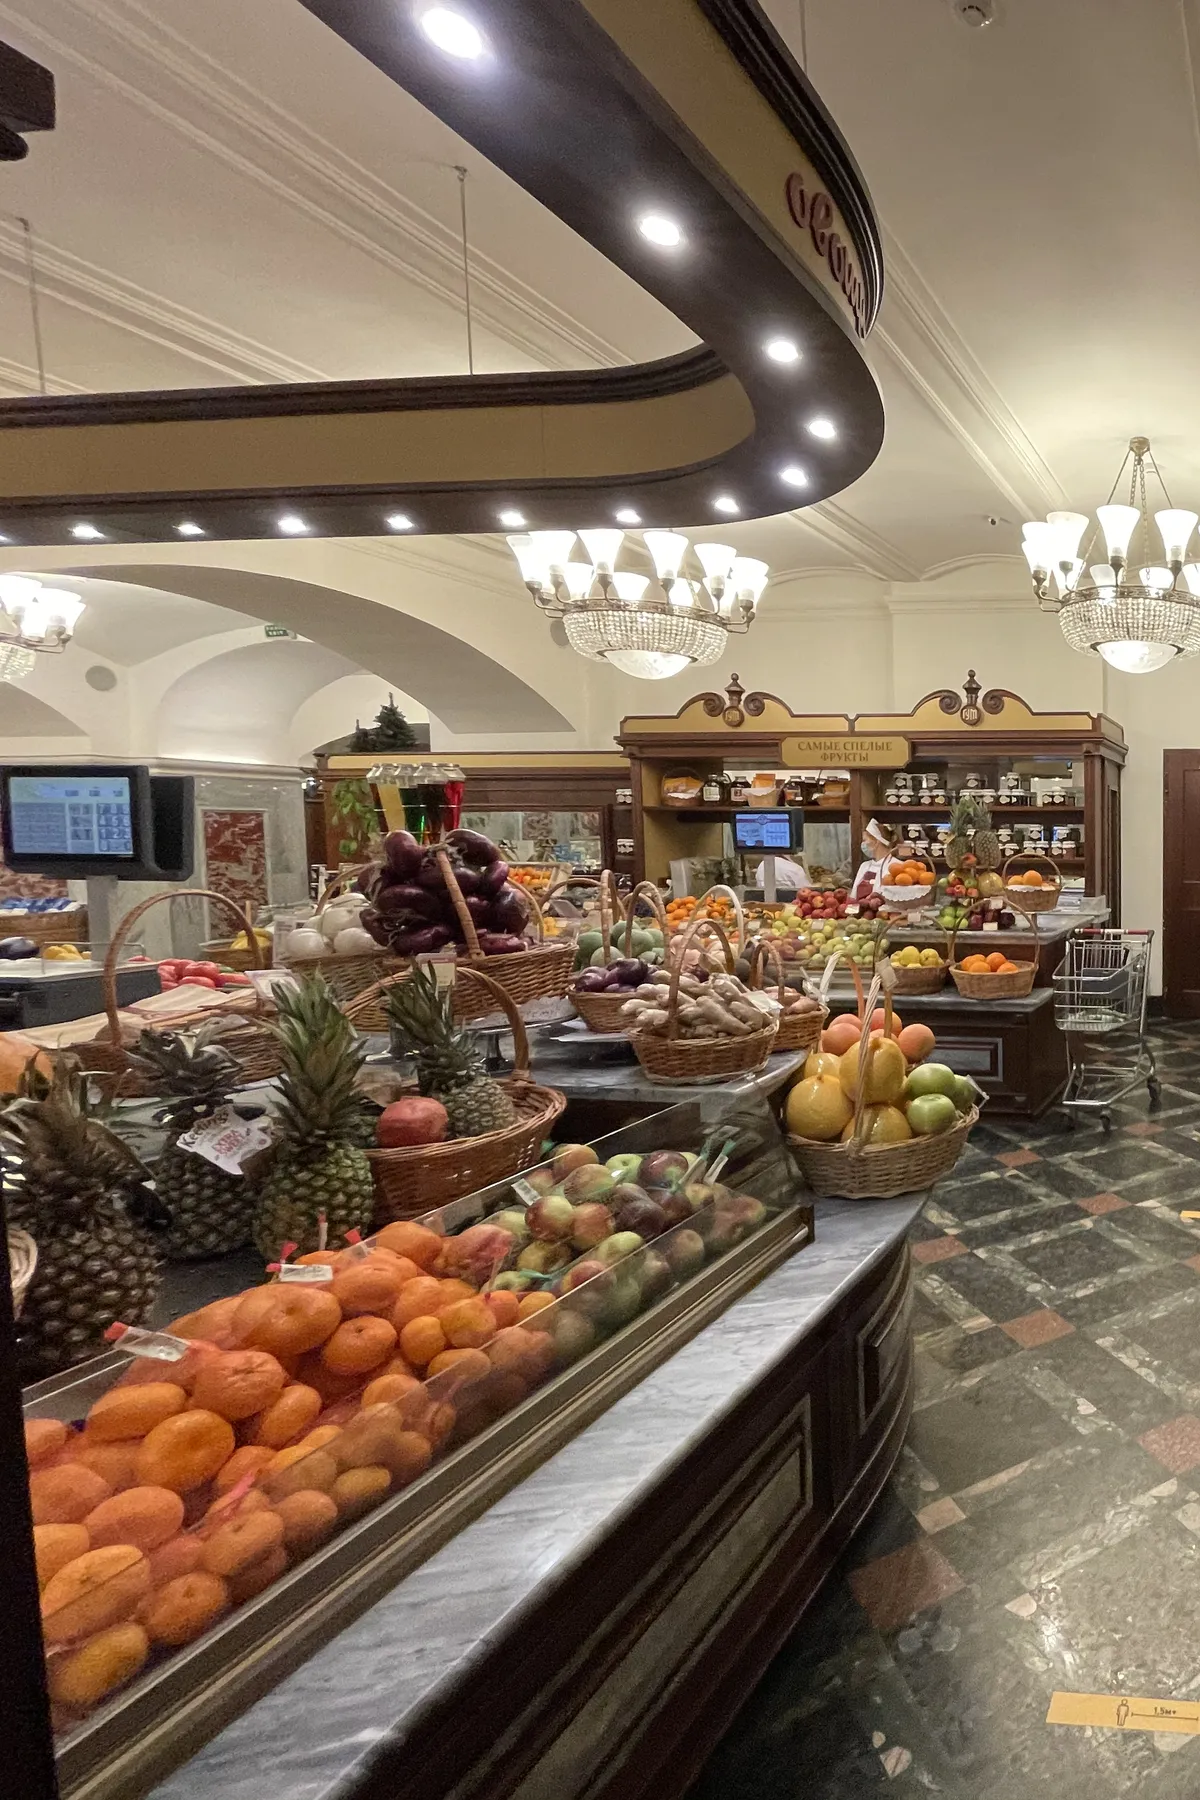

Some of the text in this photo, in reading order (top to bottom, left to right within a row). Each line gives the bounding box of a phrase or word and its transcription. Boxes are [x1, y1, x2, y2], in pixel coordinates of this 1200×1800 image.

[797, 741, 892, 751] САМЫЕ СПЕЛЫЕ
[820, 752, 869, 762] ФРУКТЫ
